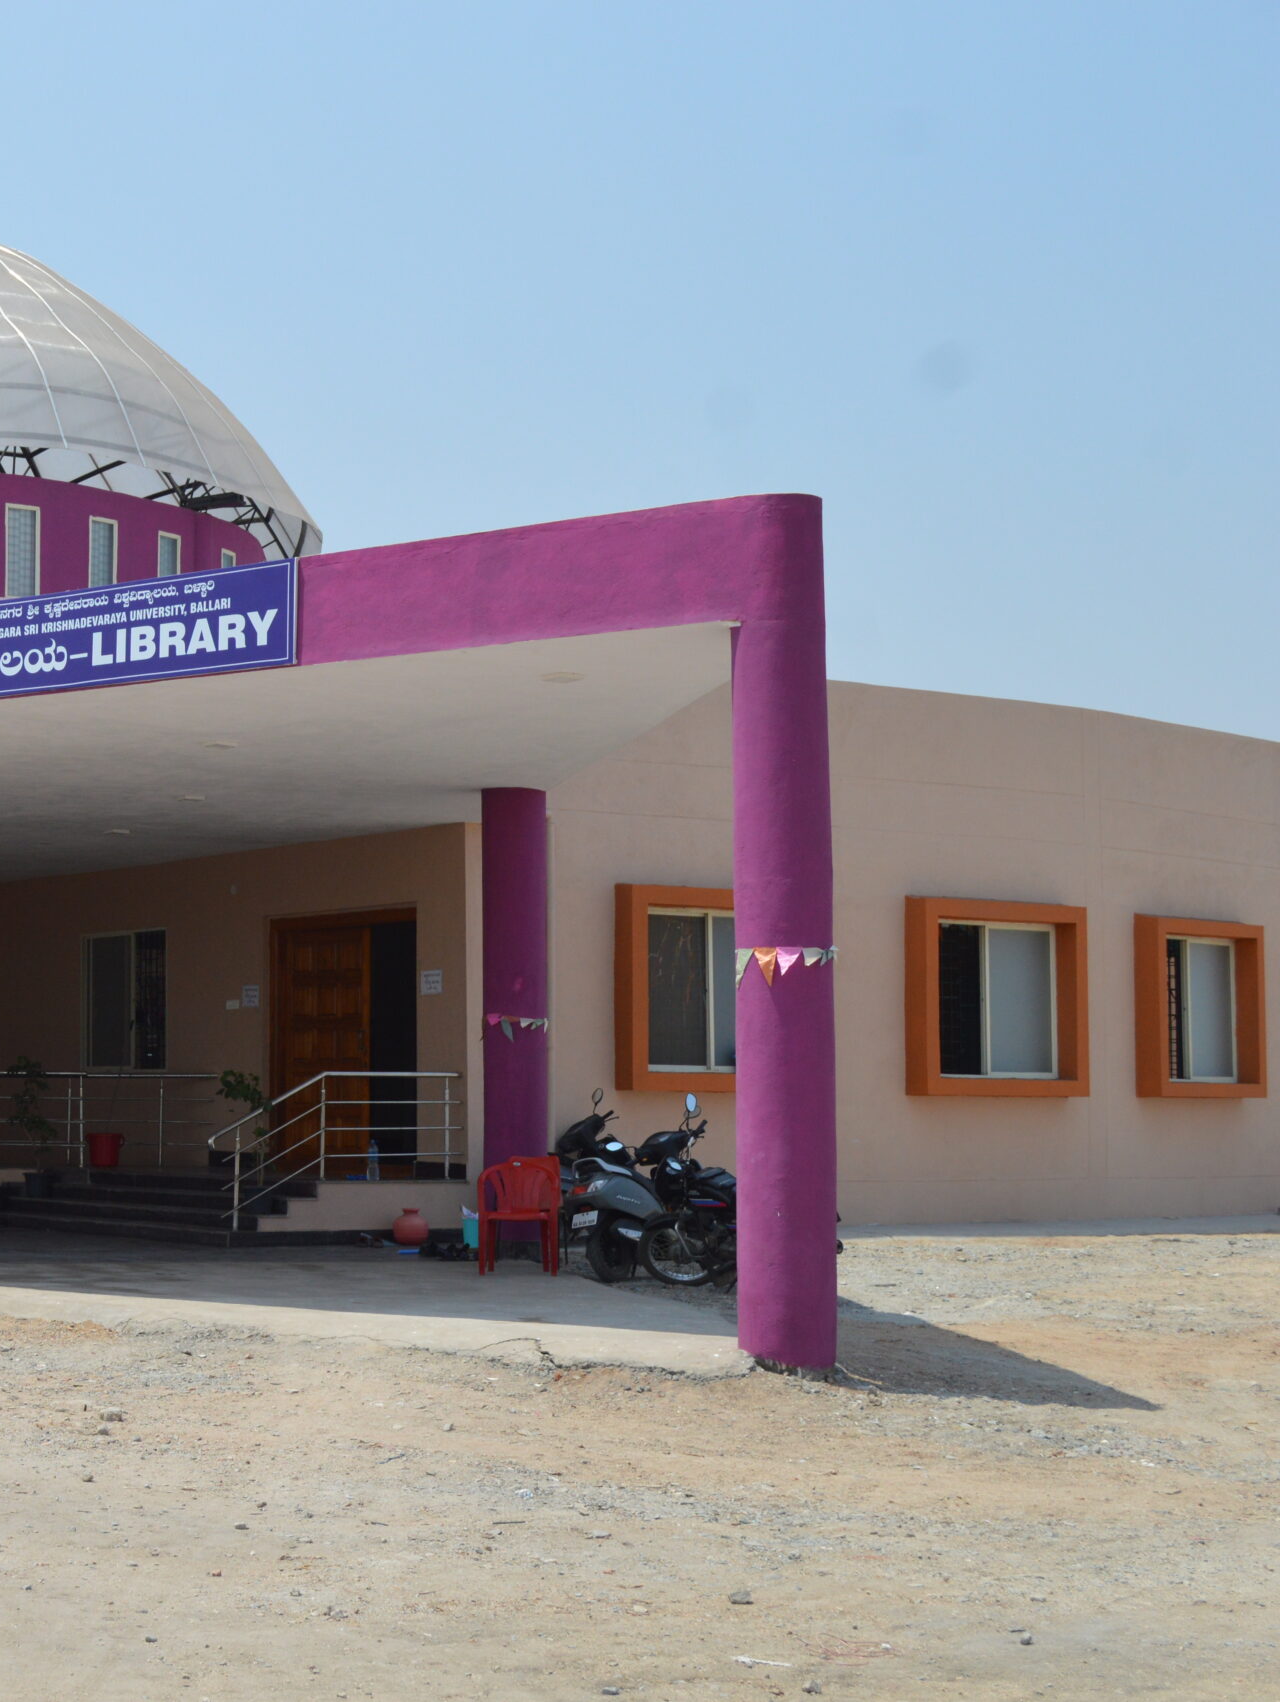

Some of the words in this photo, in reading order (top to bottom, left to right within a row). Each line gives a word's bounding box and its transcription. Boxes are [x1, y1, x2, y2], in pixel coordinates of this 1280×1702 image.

[23, 623, 39, 636] SRI
[41, 612, 128, 634] KRISHNADEVARAYA
[129, 603, 188, 622] UNIVERSITY,
[189, 597, 231, 614] BALLARI
[26, 604, 40, 620] ಶ್ರೀ
[43, 595, 109, 619] ಕೃಷ್ಣದೇವರಾಯ
